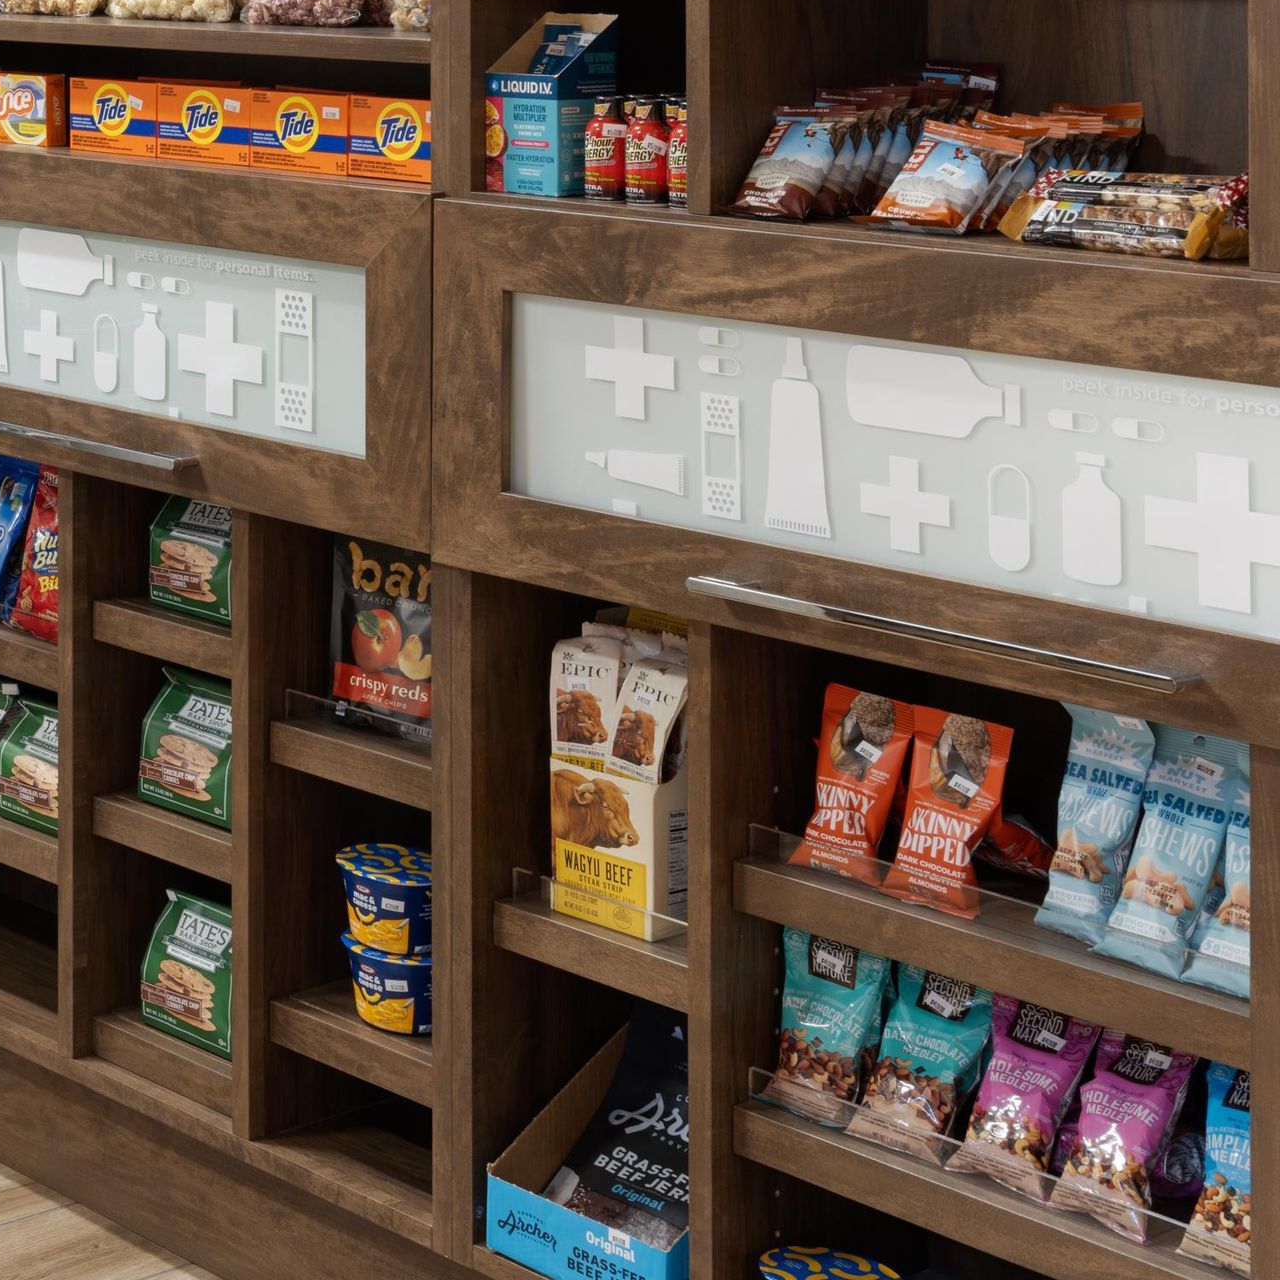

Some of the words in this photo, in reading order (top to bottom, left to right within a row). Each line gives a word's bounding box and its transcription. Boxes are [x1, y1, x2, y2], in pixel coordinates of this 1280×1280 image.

[501, 80, 539, 94] LIQUID
[95, 94, 127, 125] Tide
[185, 102, 219, 133] Tide
[513, 104, 546, 114] HYDRATION
[513, 111, 547, 122] MULTIPLIER
[279, 110, 315, 143] Tide
[379, 117, 418, 150] Tide
[584, 131, 614, 148] 5-hour
[506, 153, 525, 162] FASTER
[526, 154, 555, 164] HYDRATION
[134, 248, 162, 263] peek
[197, 254, 214, 268] for
[216, 259, 270, 276] personal
[1062, 376, 1108, 397] peek
[1114, 380, 1173, 404] inside
[1179, 384, 1209, 406] for
[1215, 393, 1280, 418] perso
[189, 516, 206, 525] BAKE
[191, 501, 232, 521] TATE'S
[561, 663, 609, 679] EPIC
[350, 672, 388, 697] crispy
[391, 683, 428, 703] reds
[190, 699, 232, 723] TATE'S
[384, 699, 407, 710] CHIPS
[1092, 737, 1124, 752] NUT
[1063, 761, 1086, 778] SEA
[1090, 768, 1143, 795] SALTED
[1159, 774, 1208, 794] HARVEST
[816, 783, 875, 814] SKINNY
[1162, 793, 1226, 825] SALTED
[908, 807, 978, 842] SKINNY
[1157, 808, 1185, 826] WHOLE
[811, 849, 849, 864] ALMONDS
[899, 832, 970, 867] DIPPED
[563, 849, 601, 877] WAGYU
[605, 862, 633, 887] BEEF
[897, 853, 918, 864] DARK
[919, 859, 967, 879] CHOCOLATE
[579, 874, 601, 888] STEAK
[602, 881, 623, 894] STRIP
[908, 877, 948, 894] ALMONDS
[352, 897, 377, 912] cheese
[182, 912, 230, 946] TATE'S
[358, 978, 382, 992] cheese
[1017, 1009, 1063, 1036] SECOND
[883, 1028, 912, 1043] DARK
[916, 1034, 970, 1068] CHOCOLATE
[989, 1071, 1035, 1094] MEDLEY
[1114, 1061, 1161, 1083] NATURE
[1086, 1104, 1132, 1125] MEDLEY
[611, 1184, 665, 1212] Original
[498, 1210, 558, 1253] Archer
[586, 1231, 635, 1263] Original
